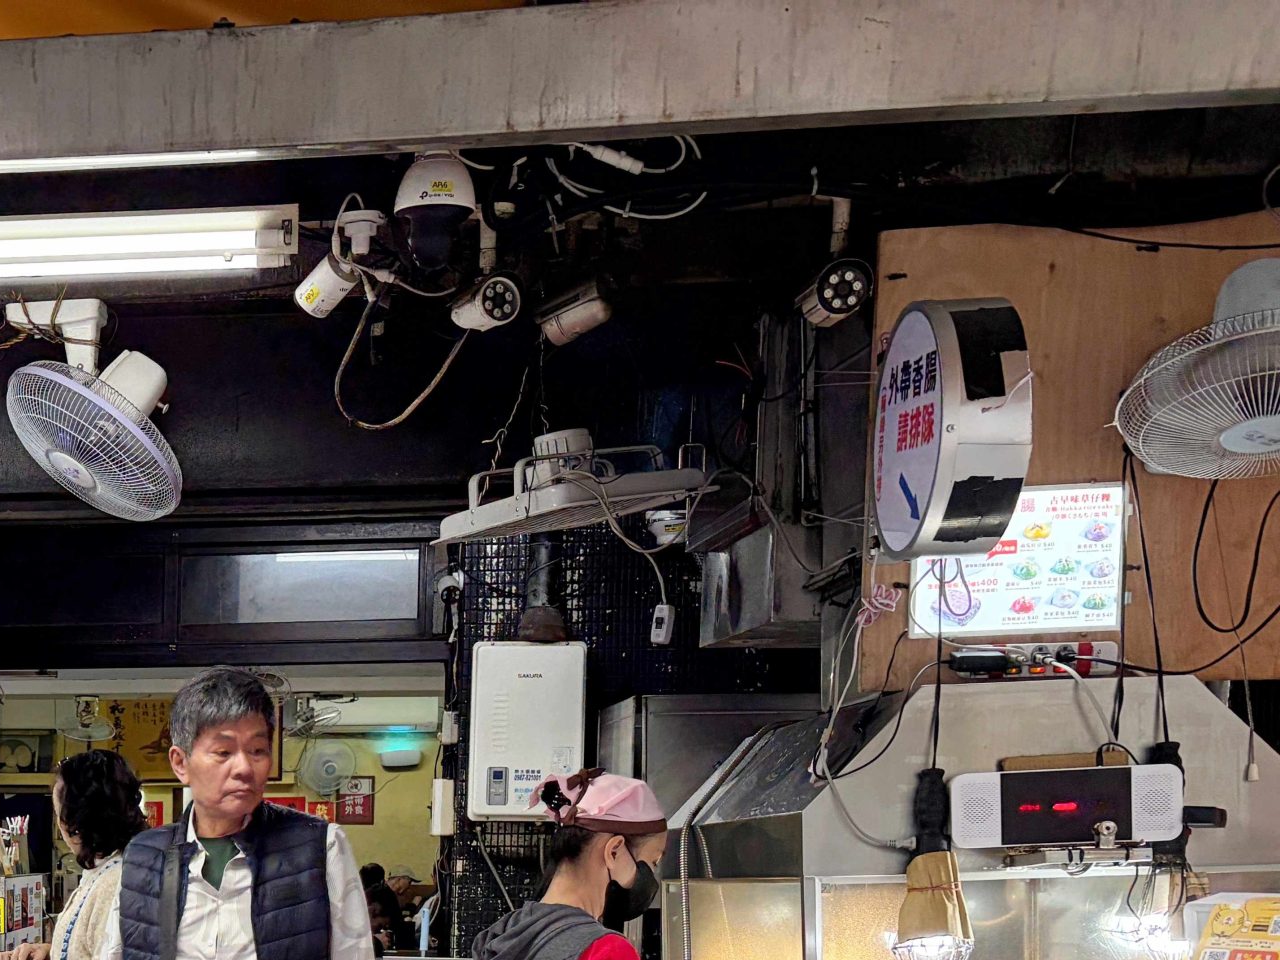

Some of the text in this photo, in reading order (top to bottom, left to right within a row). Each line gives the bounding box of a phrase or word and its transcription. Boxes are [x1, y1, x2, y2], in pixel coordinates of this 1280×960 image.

[888, 351, 937, 406] 外帶香腸
[896, 403, 935, 453] 請排隊
